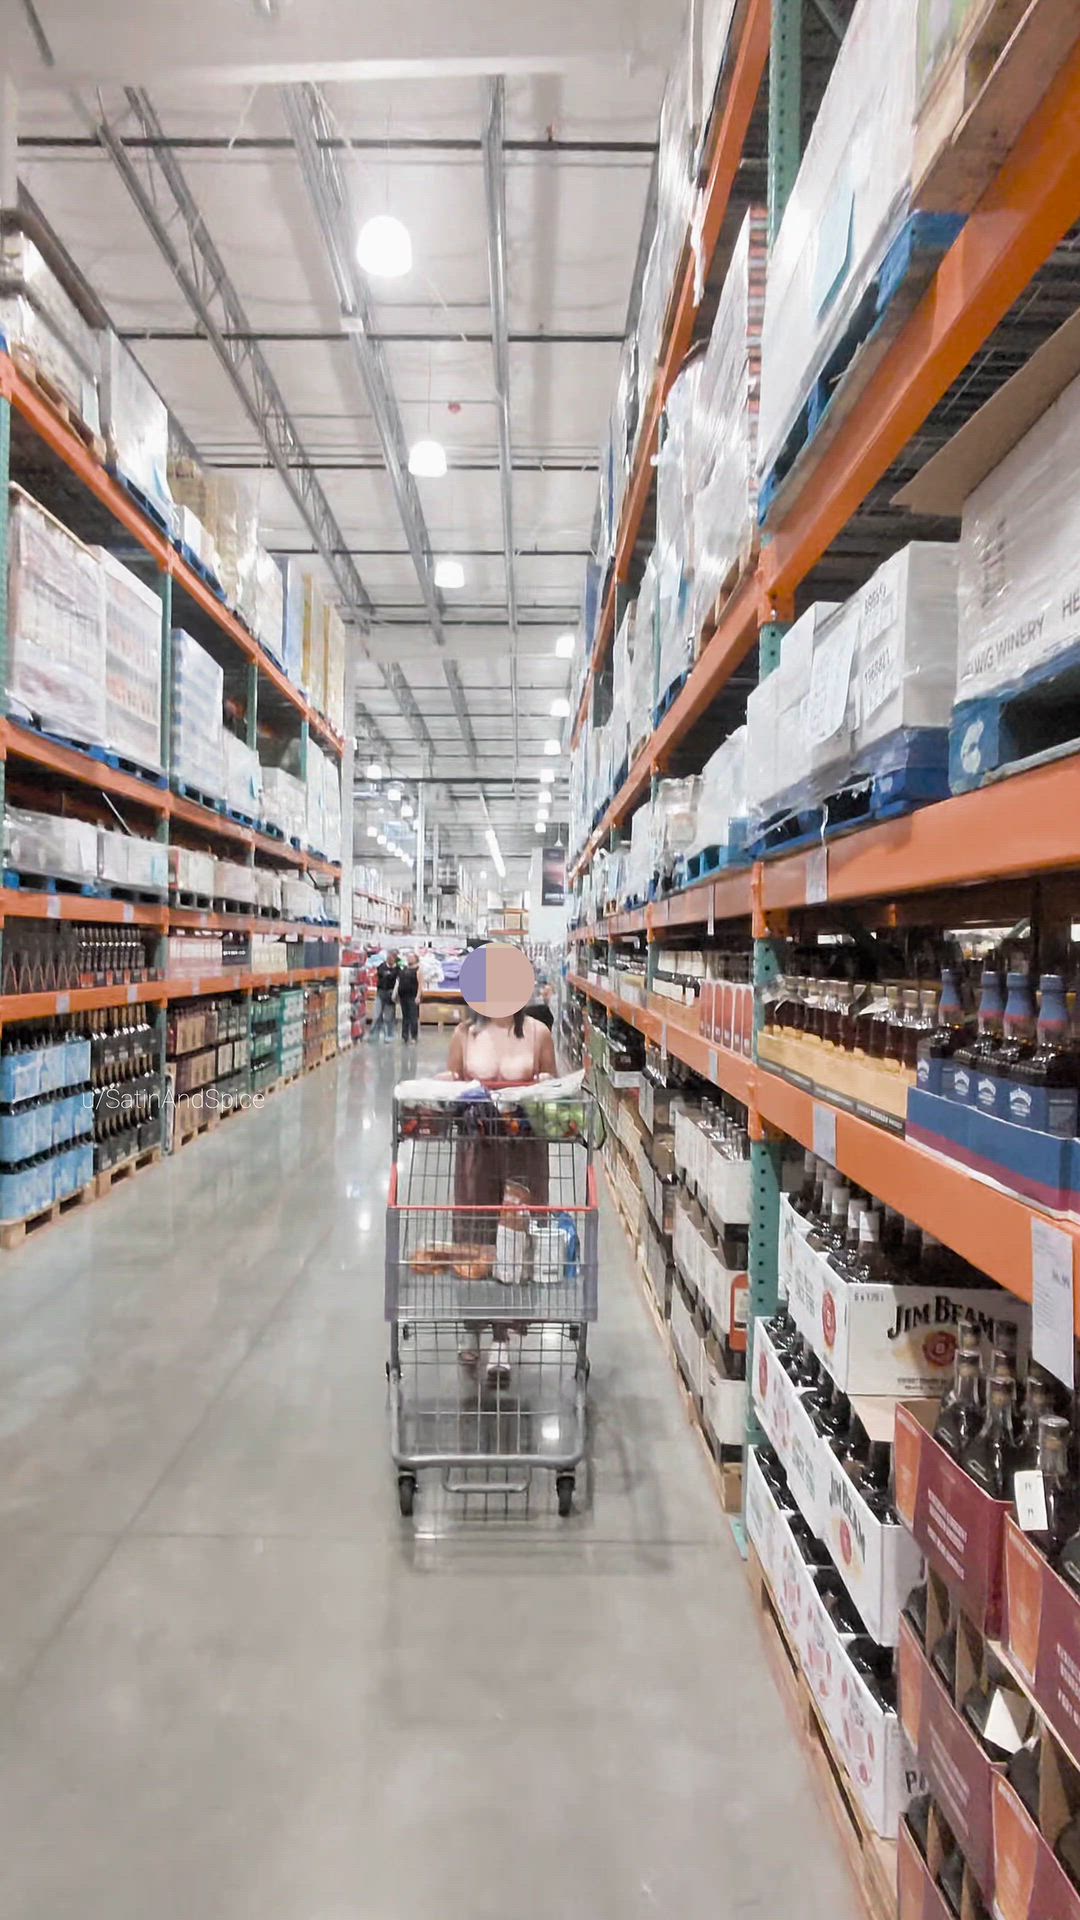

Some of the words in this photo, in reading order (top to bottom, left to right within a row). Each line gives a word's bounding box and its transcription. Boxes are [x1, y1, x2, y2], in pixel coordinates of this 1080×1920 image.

[996, 610, 1045, 660] WINERY
[887, 1303, 931, 1340] JIM
[934, 1295, 995, 1343] BEAM
